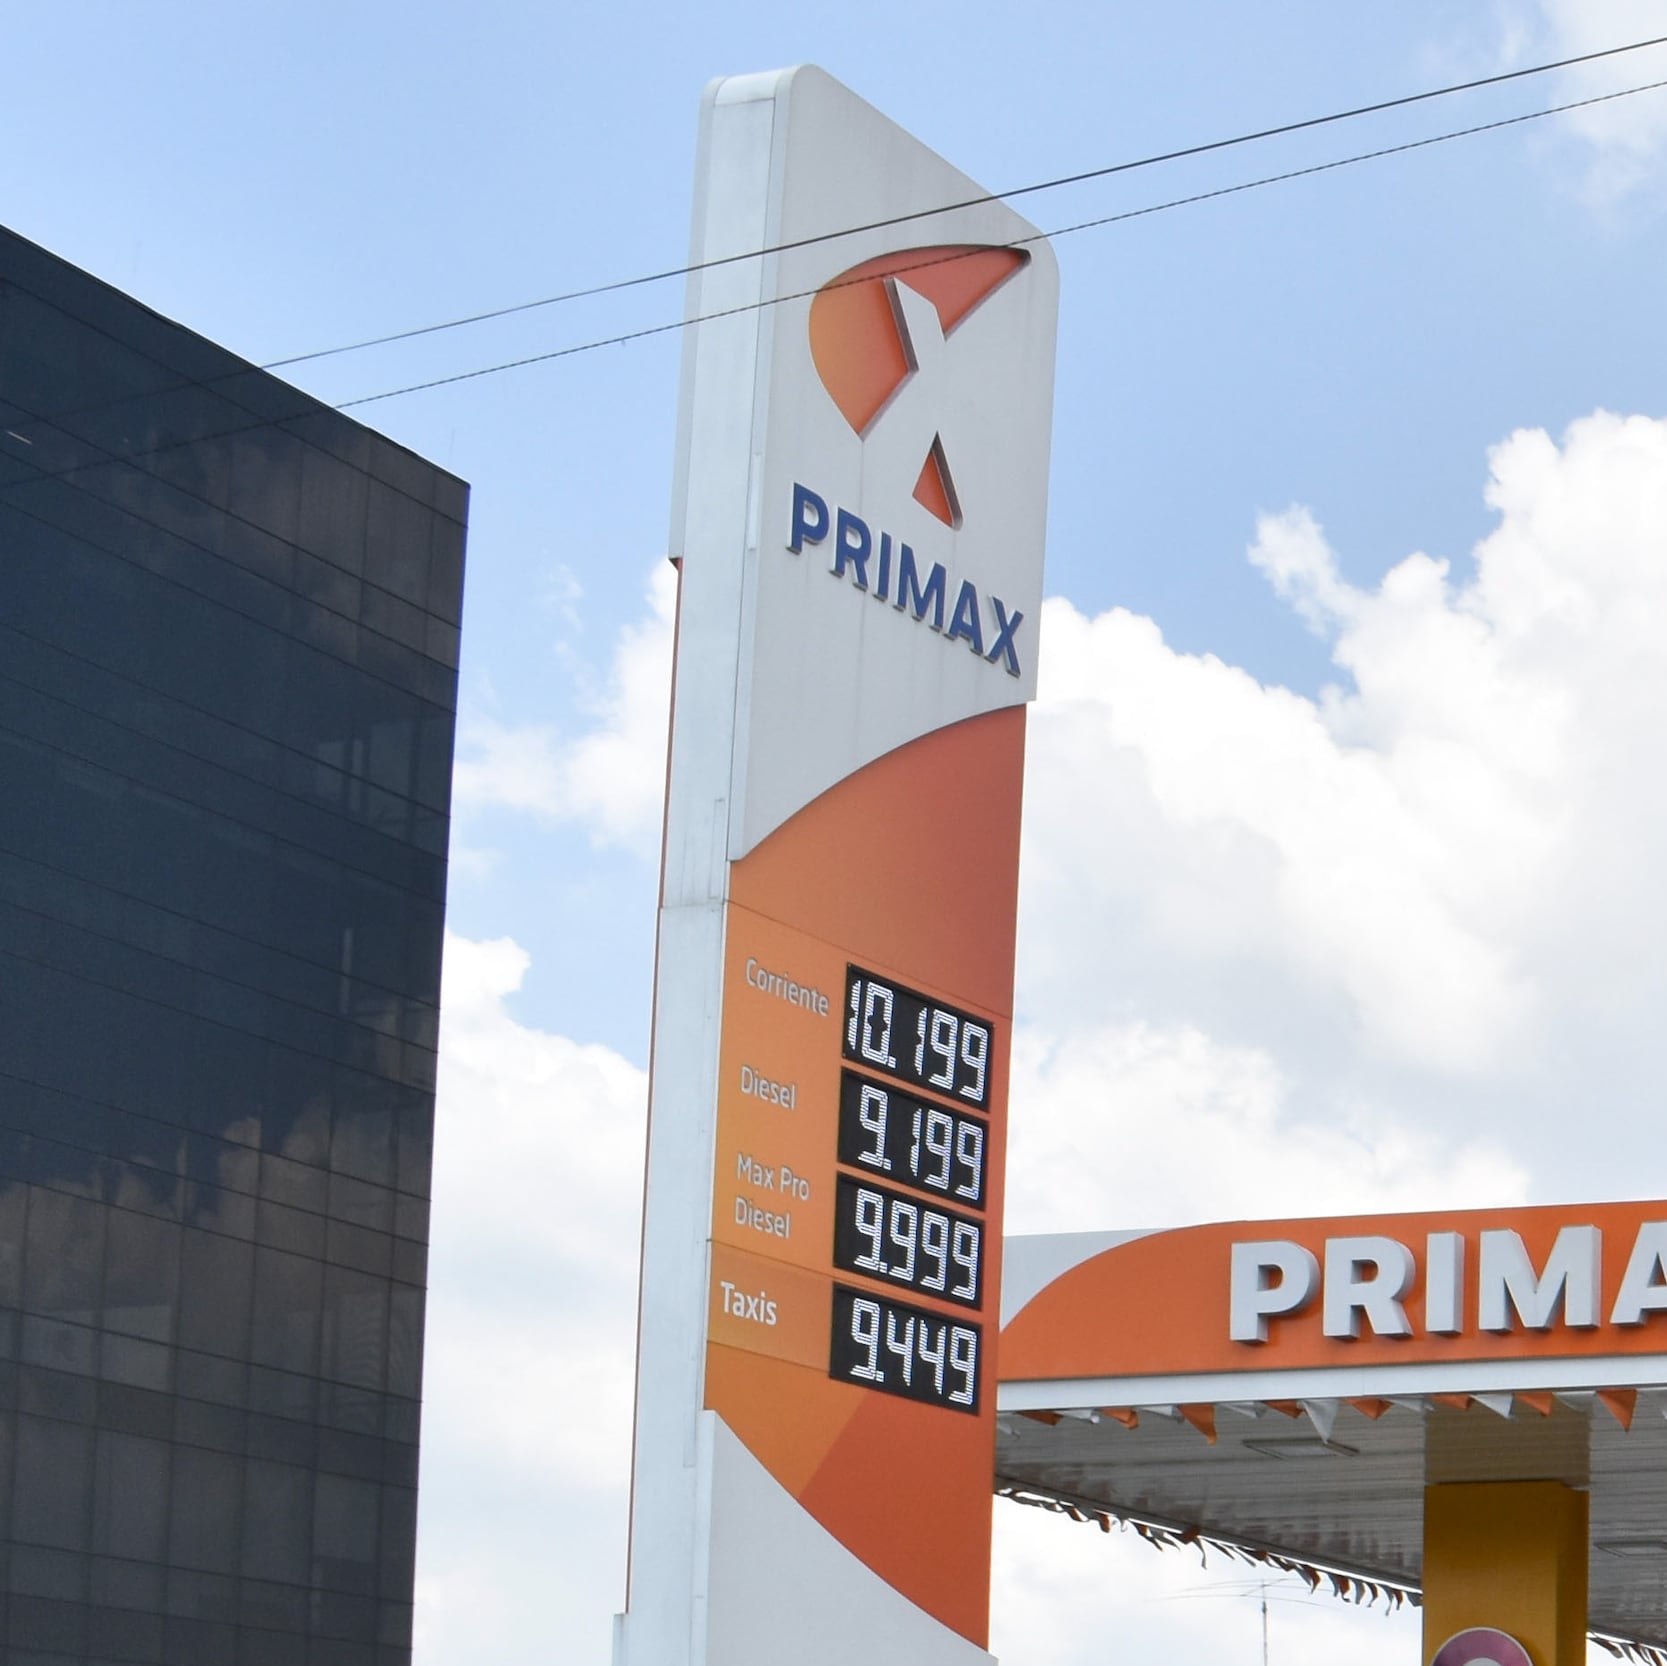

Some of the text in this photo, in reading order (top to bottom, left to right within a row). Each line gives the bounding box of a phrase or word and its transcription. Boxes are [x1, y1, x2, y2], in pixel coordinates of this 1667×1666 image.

[786, 482, 1025, 677] PRIMAX
[746, 959, 829, 1016] Corriente
[848, 980, 989, 1102] 10.199
[741, 1064, 796, 1109] Diesel
[737, 1153, 809, 1200] Max Pro
[858, 1084, 985, 1200] 9.199
[735, 1197, 790, 1239] Diesel
[854, 1188, 981, 1301] 9.999
[720, 1281, 777, 1326] Taxis
[850, 1298, 978, 1405] 9.449
